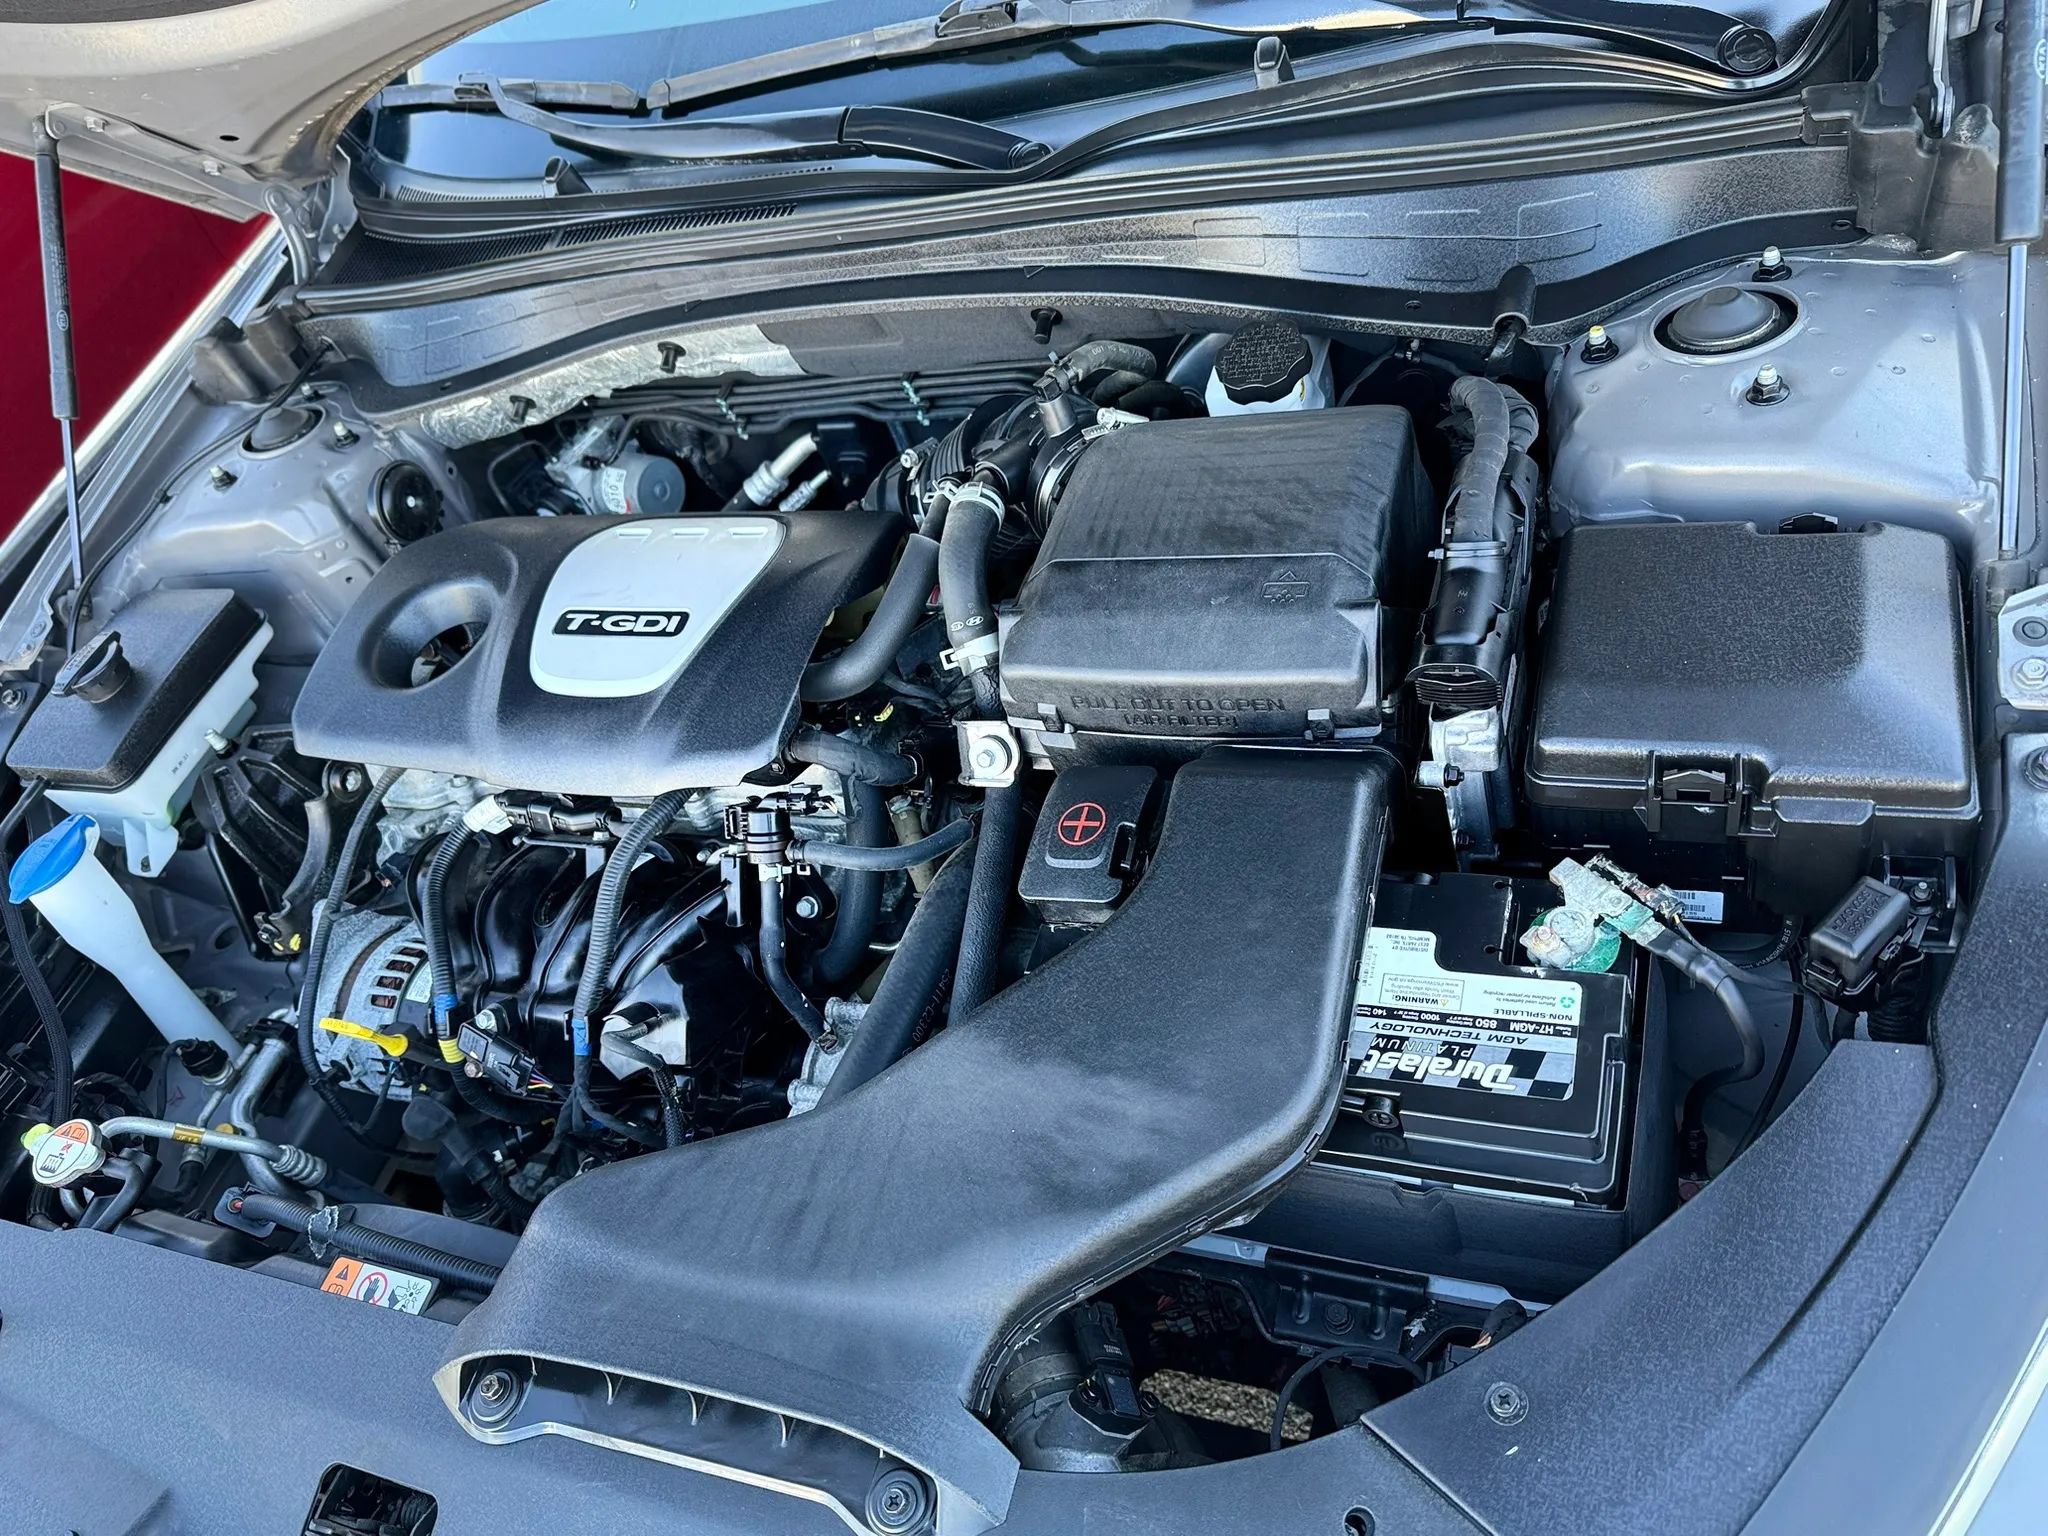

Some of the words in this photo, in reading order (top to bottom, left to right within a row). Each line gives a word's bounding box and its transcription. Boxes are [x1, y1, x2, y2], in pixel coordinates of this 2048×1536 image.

[1071, 695, 1127, 711] PULL
[1131, 698, 1176, 712] OUT
[1180, 699, 1213, 713] TO
[1219, 699, 1286, 713] OPEN
[1392, 995, 1438, 1005] WARNING:
[1372, 1008, 1387, 1016] 140
[1420, 1012, 1440, 1022] 1000
[1493, 1008, 1573, 1020] NON-SPILLABLE
[1476, 1018, 1498, 1028] 850
[1509, 1022, 1554, 1034] H7-AGM
[1370, 1021, 1482, 1040] TECHNOLOGY
[1488, 1034, 1528, 1044] AGM
[1370, 1038, 1473, 1058] PLATINUM
[1362, 1049, 1516, 1090] Duralast
